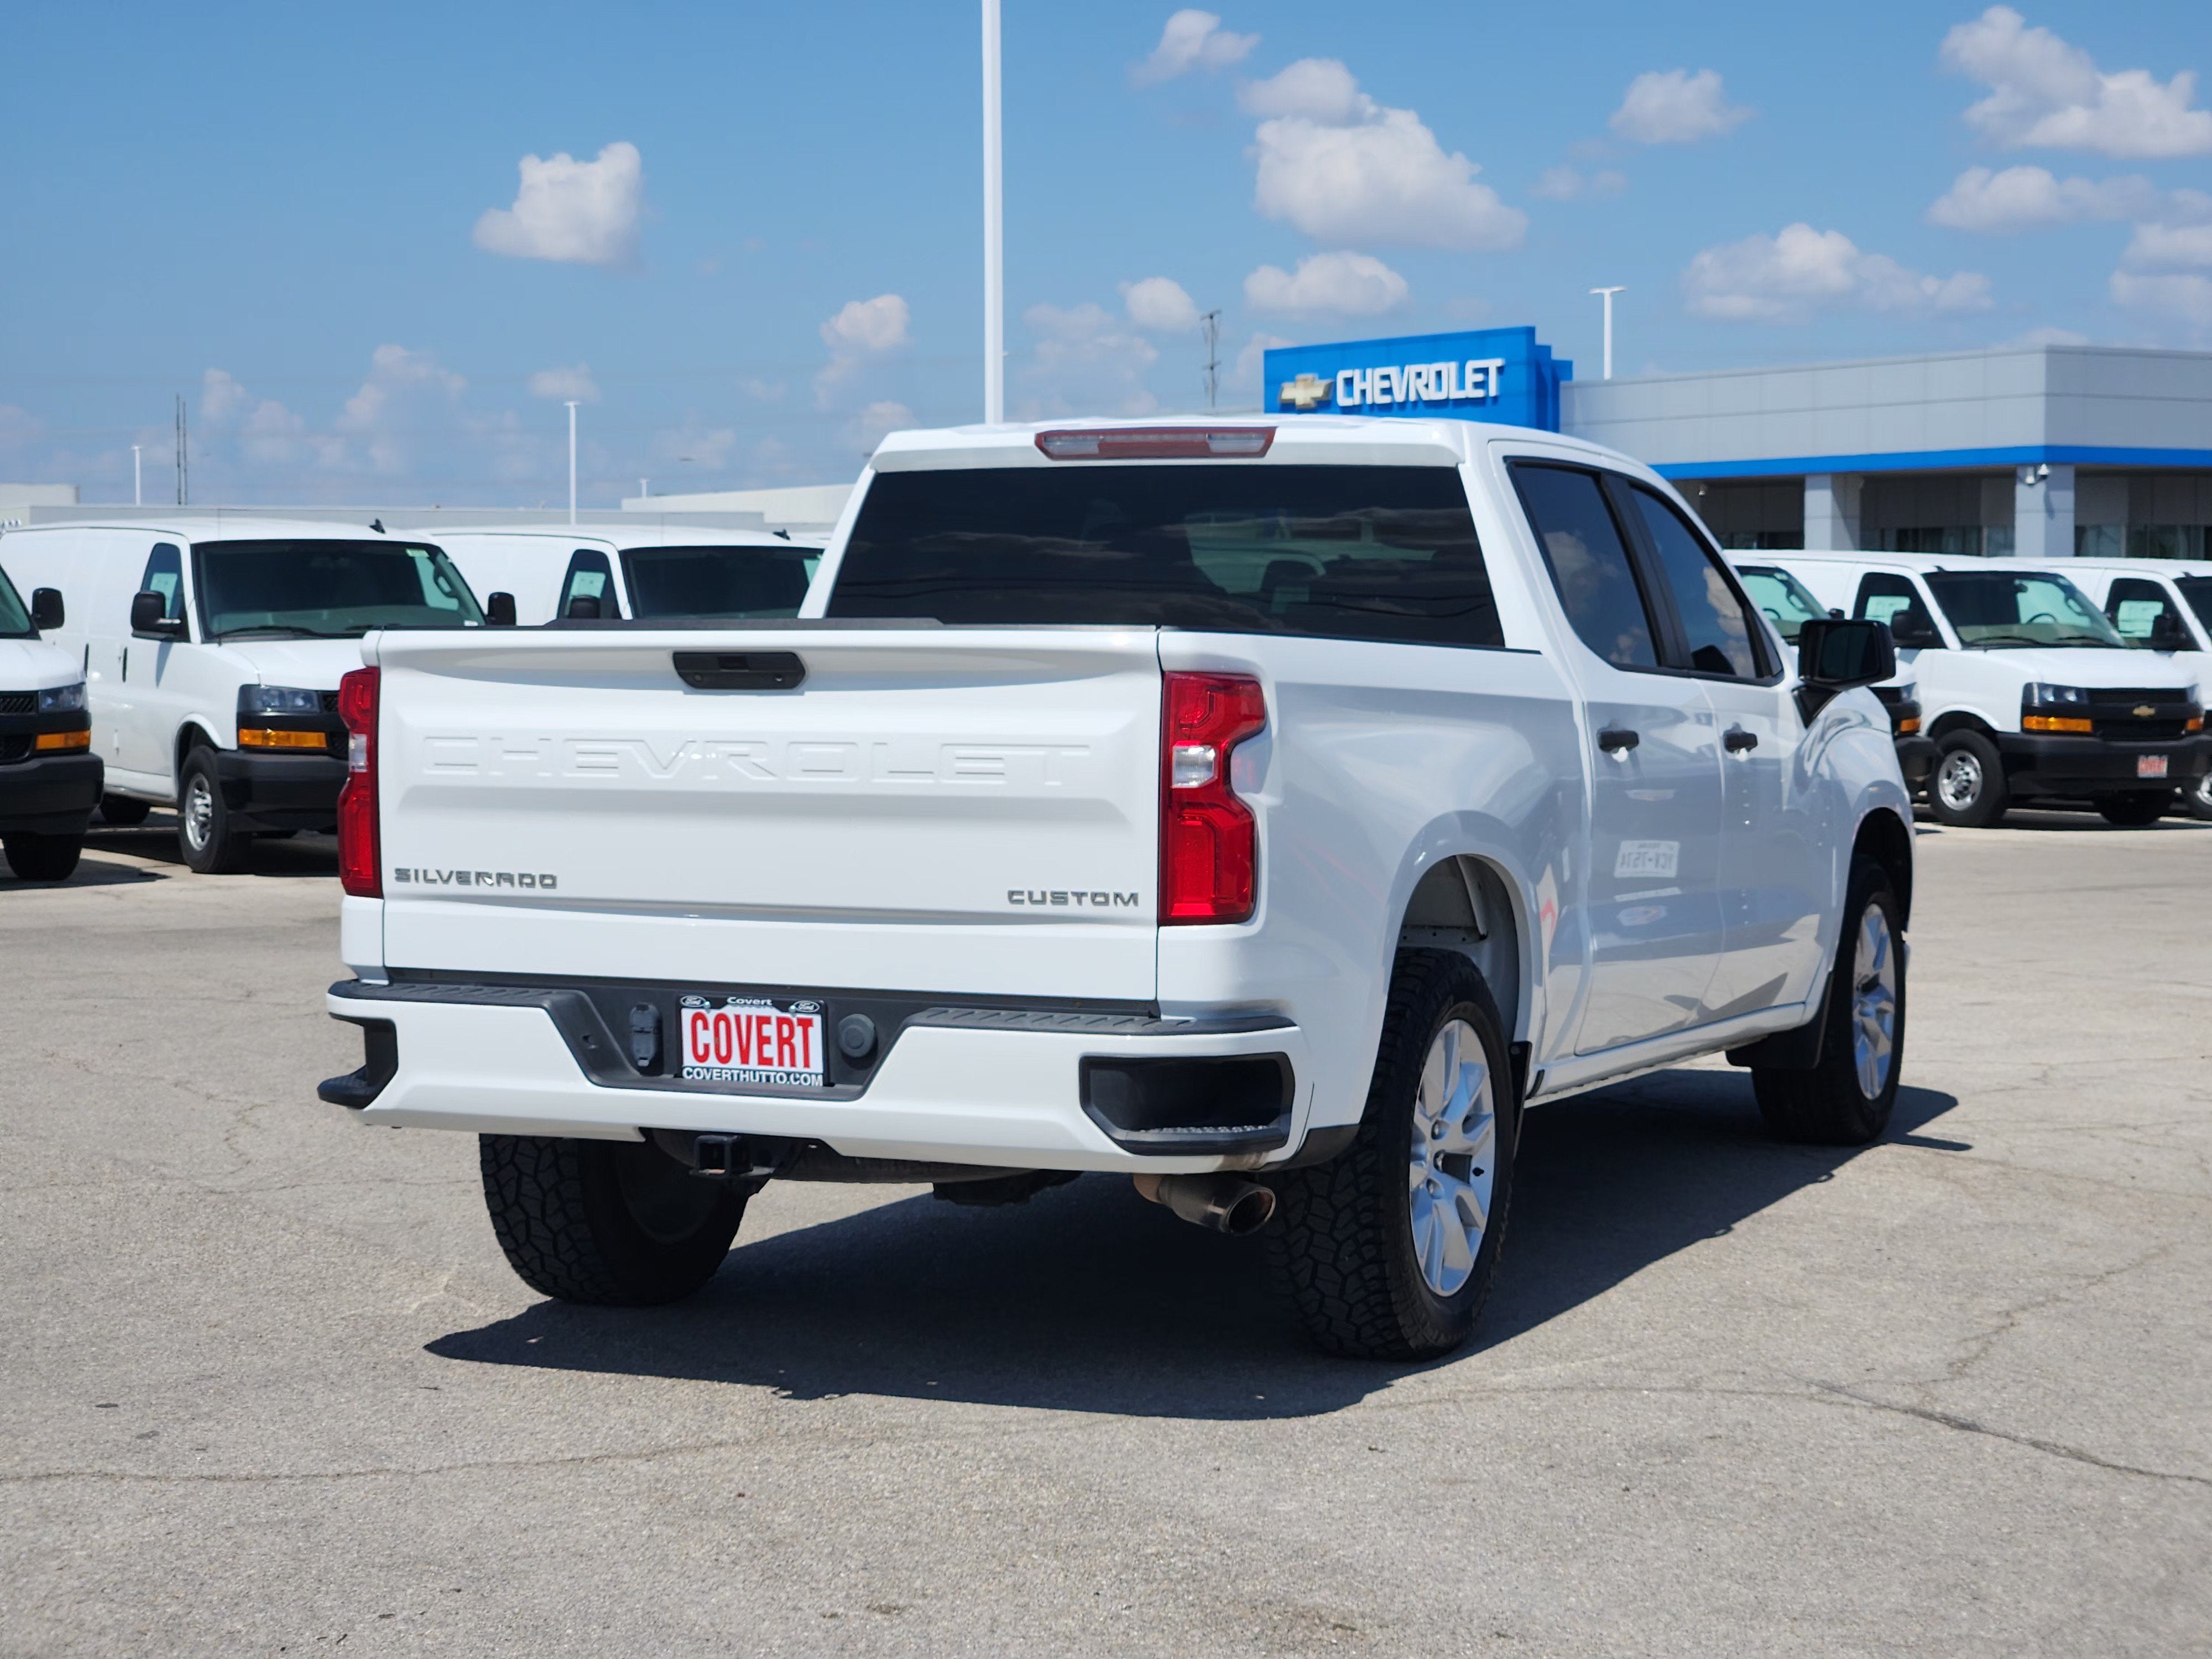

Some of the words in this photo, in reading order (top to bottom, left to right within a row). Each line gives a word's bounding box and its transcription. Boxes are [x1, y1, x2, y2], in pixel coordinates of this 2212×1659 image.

[1337, 358, 1505, 406] CHEVROLET
[424, 736, 1090, 785] CHEVROLET
[394, 868, 557, 889] SILVERADO
[1007, 890, 1139, 907] CUSTOM
[727, 997, 773, 1006] Covert
[691, 1011, 814, 1068] COVERT
[681, 1067, 824, 1087] COVERTHUTTO.COM
